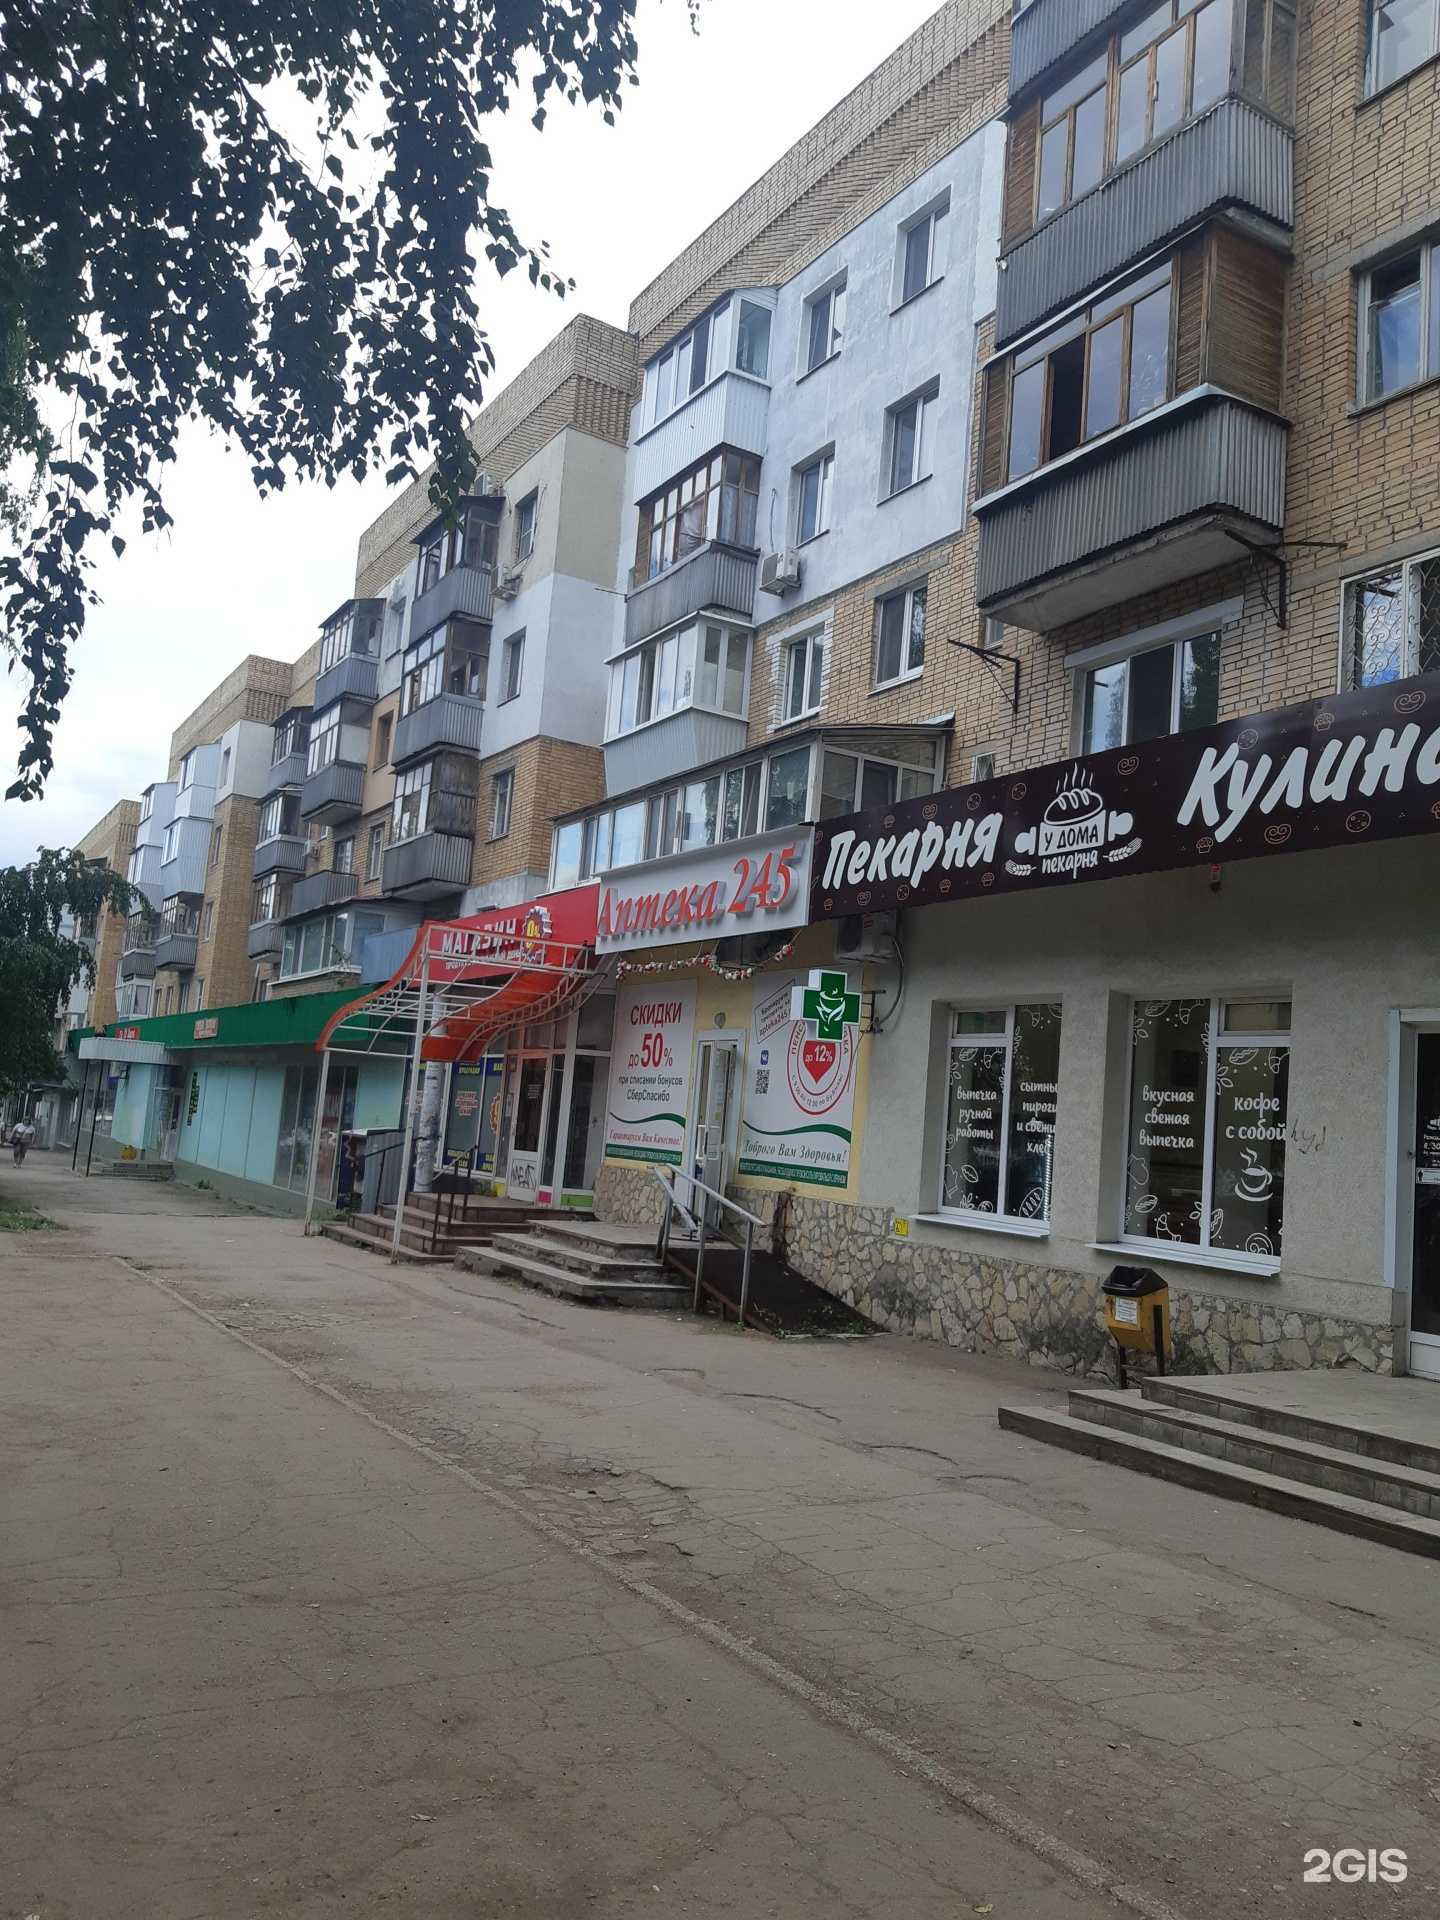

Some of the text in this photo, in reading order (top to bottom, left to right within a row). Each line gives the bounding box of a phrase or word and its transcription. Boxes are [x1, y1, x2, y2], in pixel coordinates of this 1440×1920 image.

[1045, 824, 1099, 852] У ДОМА
[822, 812, 1003, 889] Пекарня
[1041, 849, 1098, 879] пекарня
[597, 842, 799, 936] Аптека 245
[630, 1001, 683, 1028] СКИДКИ
[957, 1085, 997, 1100] выпечка
[1020, 1081, 1058, 1093] сытны
[1142, 1084, 1195, 1107] вкусная
[959, 1107, 993, 1123] ручной
[1234, 1091, 1280, 1119] кофе
[1025, 1117, 1056, 1134] свежи
[1144, 1107, 1190, 1126] свежая
[955, 1123, 994, 1142] работы
[1139, 1128, 1194, 1149] выпечка
[1225, 1125, 1235, 1139] с
[1238, 1118, 1287, 1141] собой
[778, 1142, 797, 1157] Вам
